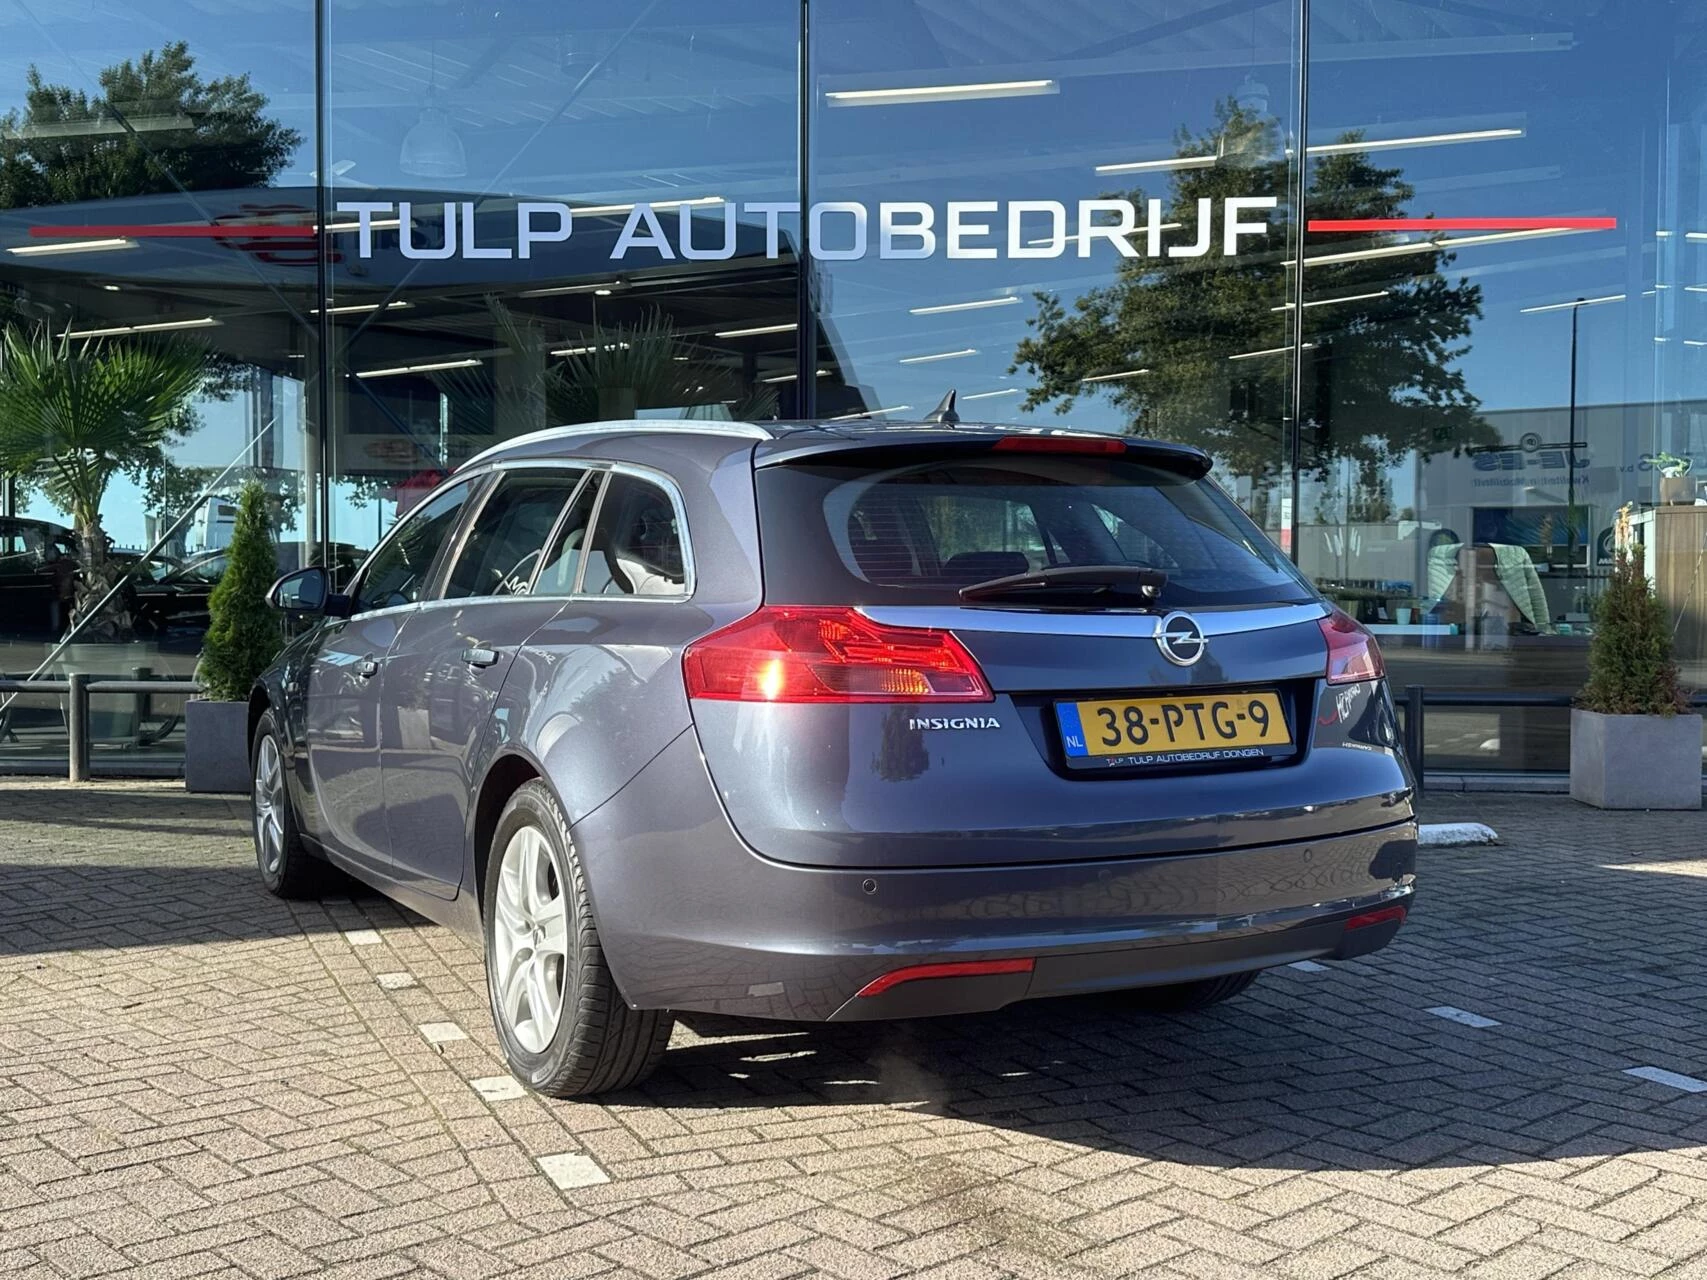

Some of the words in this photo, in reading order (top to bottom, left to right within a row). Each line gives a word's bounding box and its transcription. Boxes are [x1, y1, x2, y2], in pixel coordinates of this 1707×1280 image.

[336, 201, 573, 260] TULP
[609, 196, 1278, 261] AUTOBEDRIJF
[909, 717, 1001, 731] INSIGNIA
[1097, 699, 1269, 747] 38-PTG-9
[1066, 735, 1084, 748] NL
[1128, 754, 1153, 766] TULP
[1156, 751, 1222, 763] AUTOBEDRIJF
[1223, 747, 1265, 759] DONGEN
